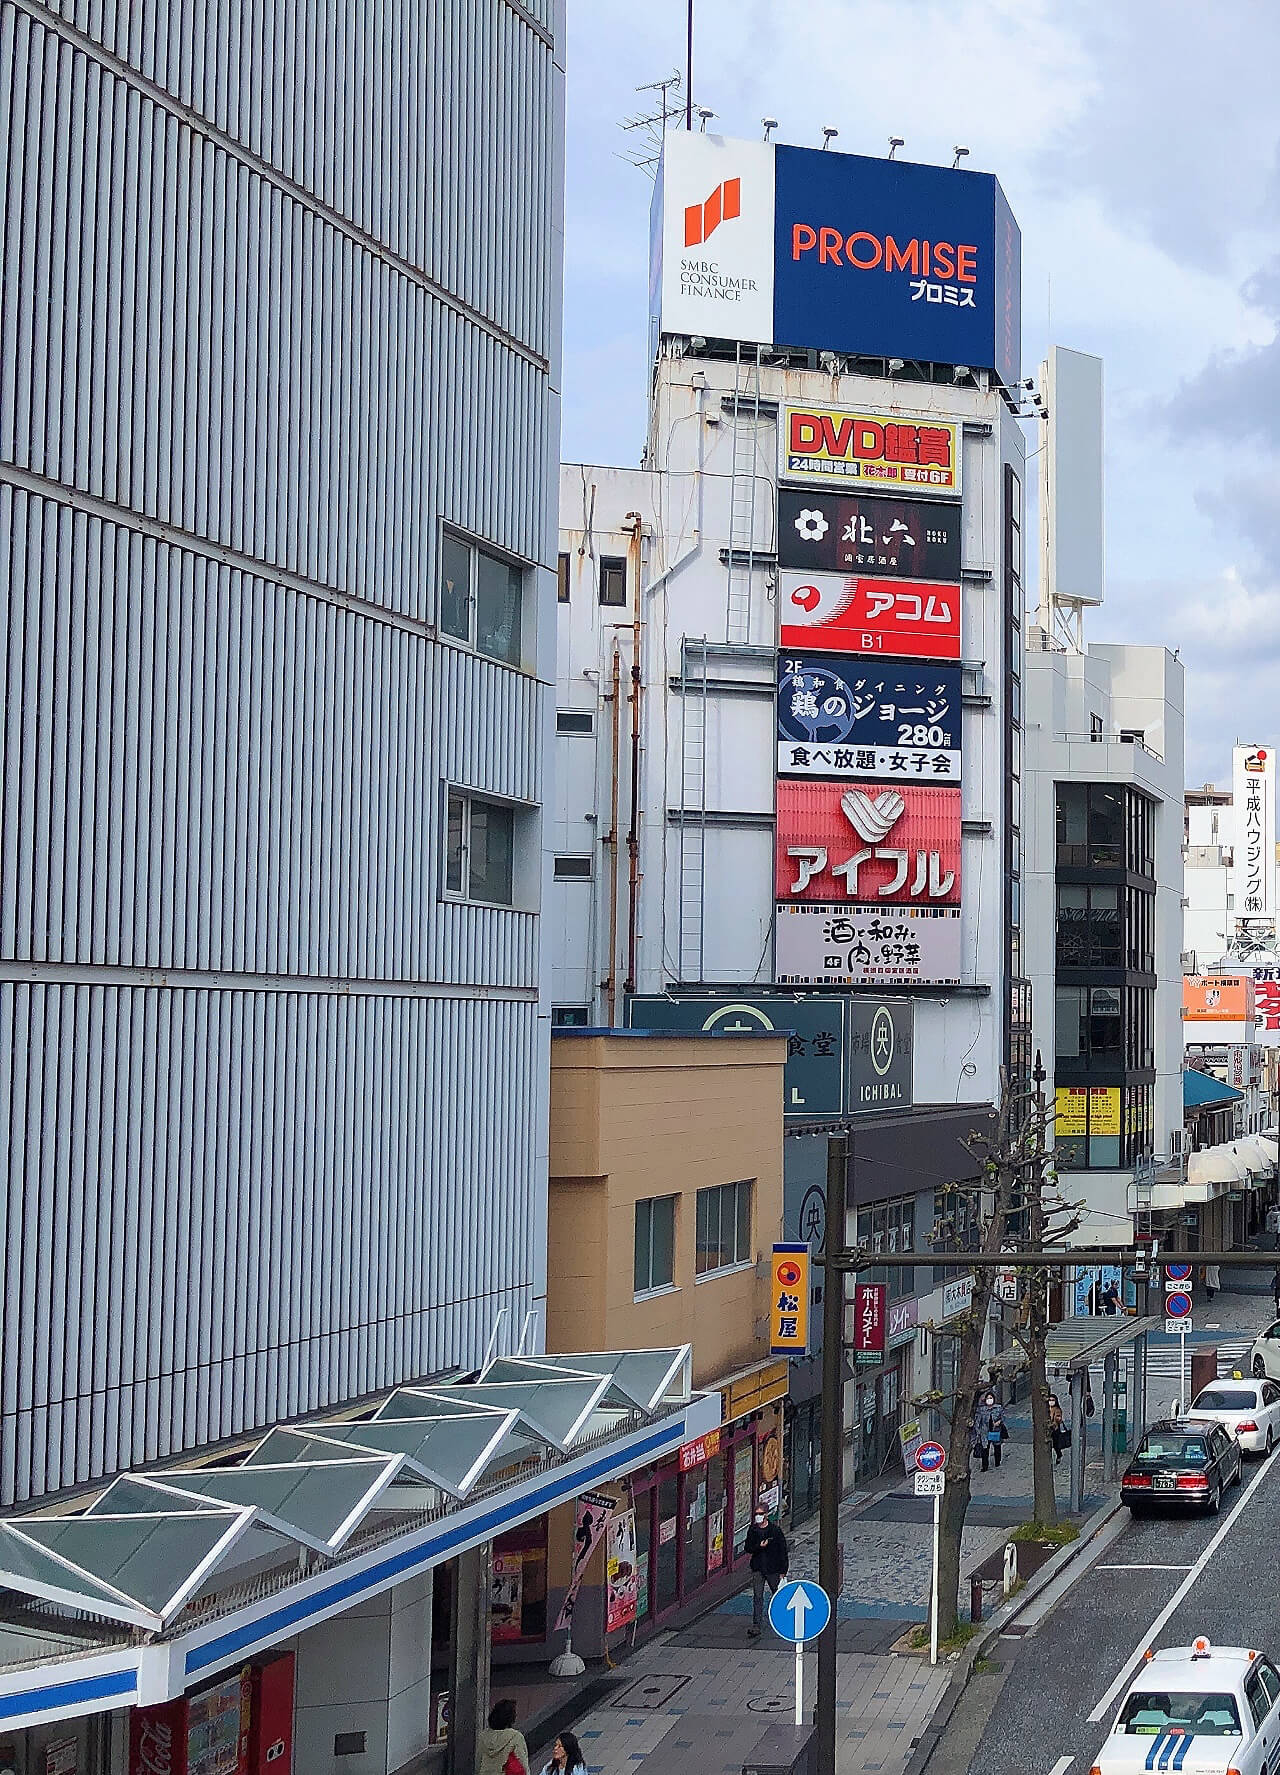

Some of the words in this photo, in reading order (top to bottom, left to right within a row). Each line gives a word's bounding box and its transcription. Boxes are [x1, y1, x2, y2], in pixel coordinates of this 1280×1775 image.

[792, 224, 977, 283] PROMISE
[681, 259, 719, 275] SMBC
[680, 271, 758, 292] CONSUMER
[681, 284, 742, 302] FINANCE
[910, 279, 977, 308] プロミス
[865, 591, 952, 623] アコム
[861, 633, 884, 649] B1
[784, 659, 803, 675] 2F
[789, 691, 951, 724] 鶏のジョージ
[786, 846, 955, 897] アイフル
[826, 957, 841, 967] 4F
[787, 1031, 837, 1058] 食堂
[860, 1083, 903, 1102] ICHIBAL
[776, 1291, 799, 1339] 松屋
[862, 1287, 874, 1348] ホームメイト
[917, 1484, 943, 1492] ここから
